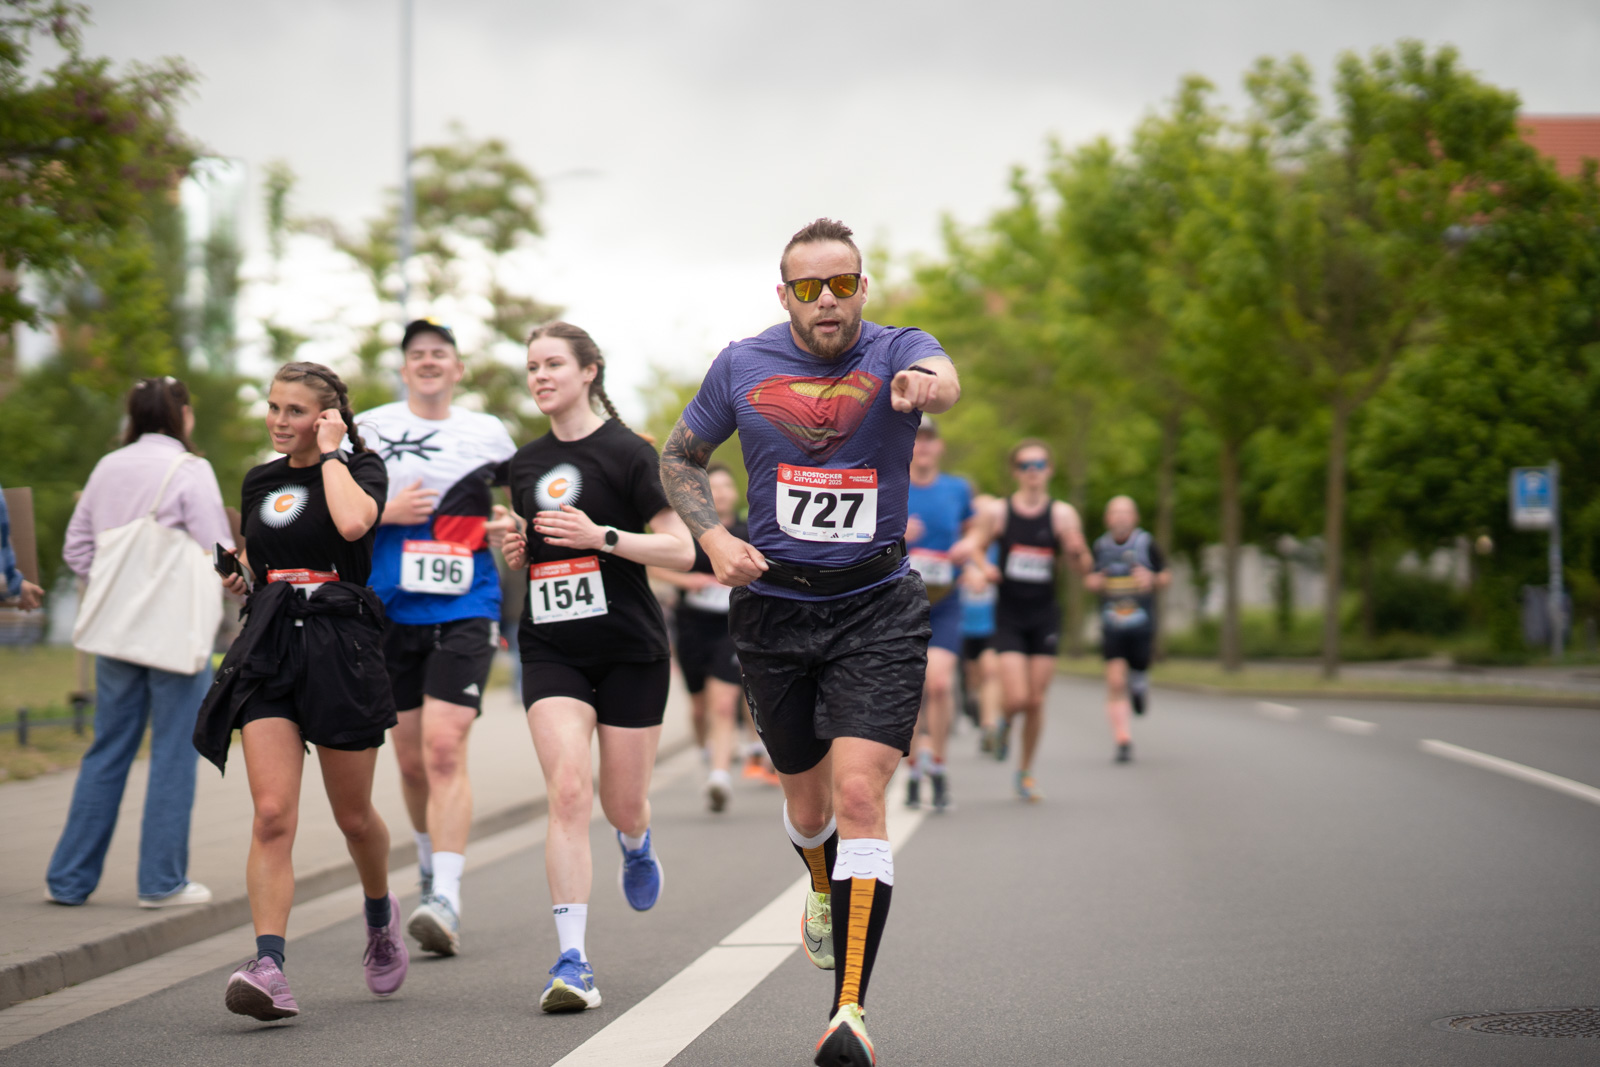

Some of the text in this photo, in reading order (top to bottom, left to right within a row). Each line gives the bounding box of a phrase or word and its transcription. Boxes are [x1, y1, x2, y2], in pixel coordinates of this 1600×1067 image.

[794, 476, 827, 484] CITYLAUF
[802, 471, 842, 479] ROSTOCKER
[788, 489, 864, 528] 727
[416, 558, 463, 584] 196
[539, 577, 595, 611] 154
